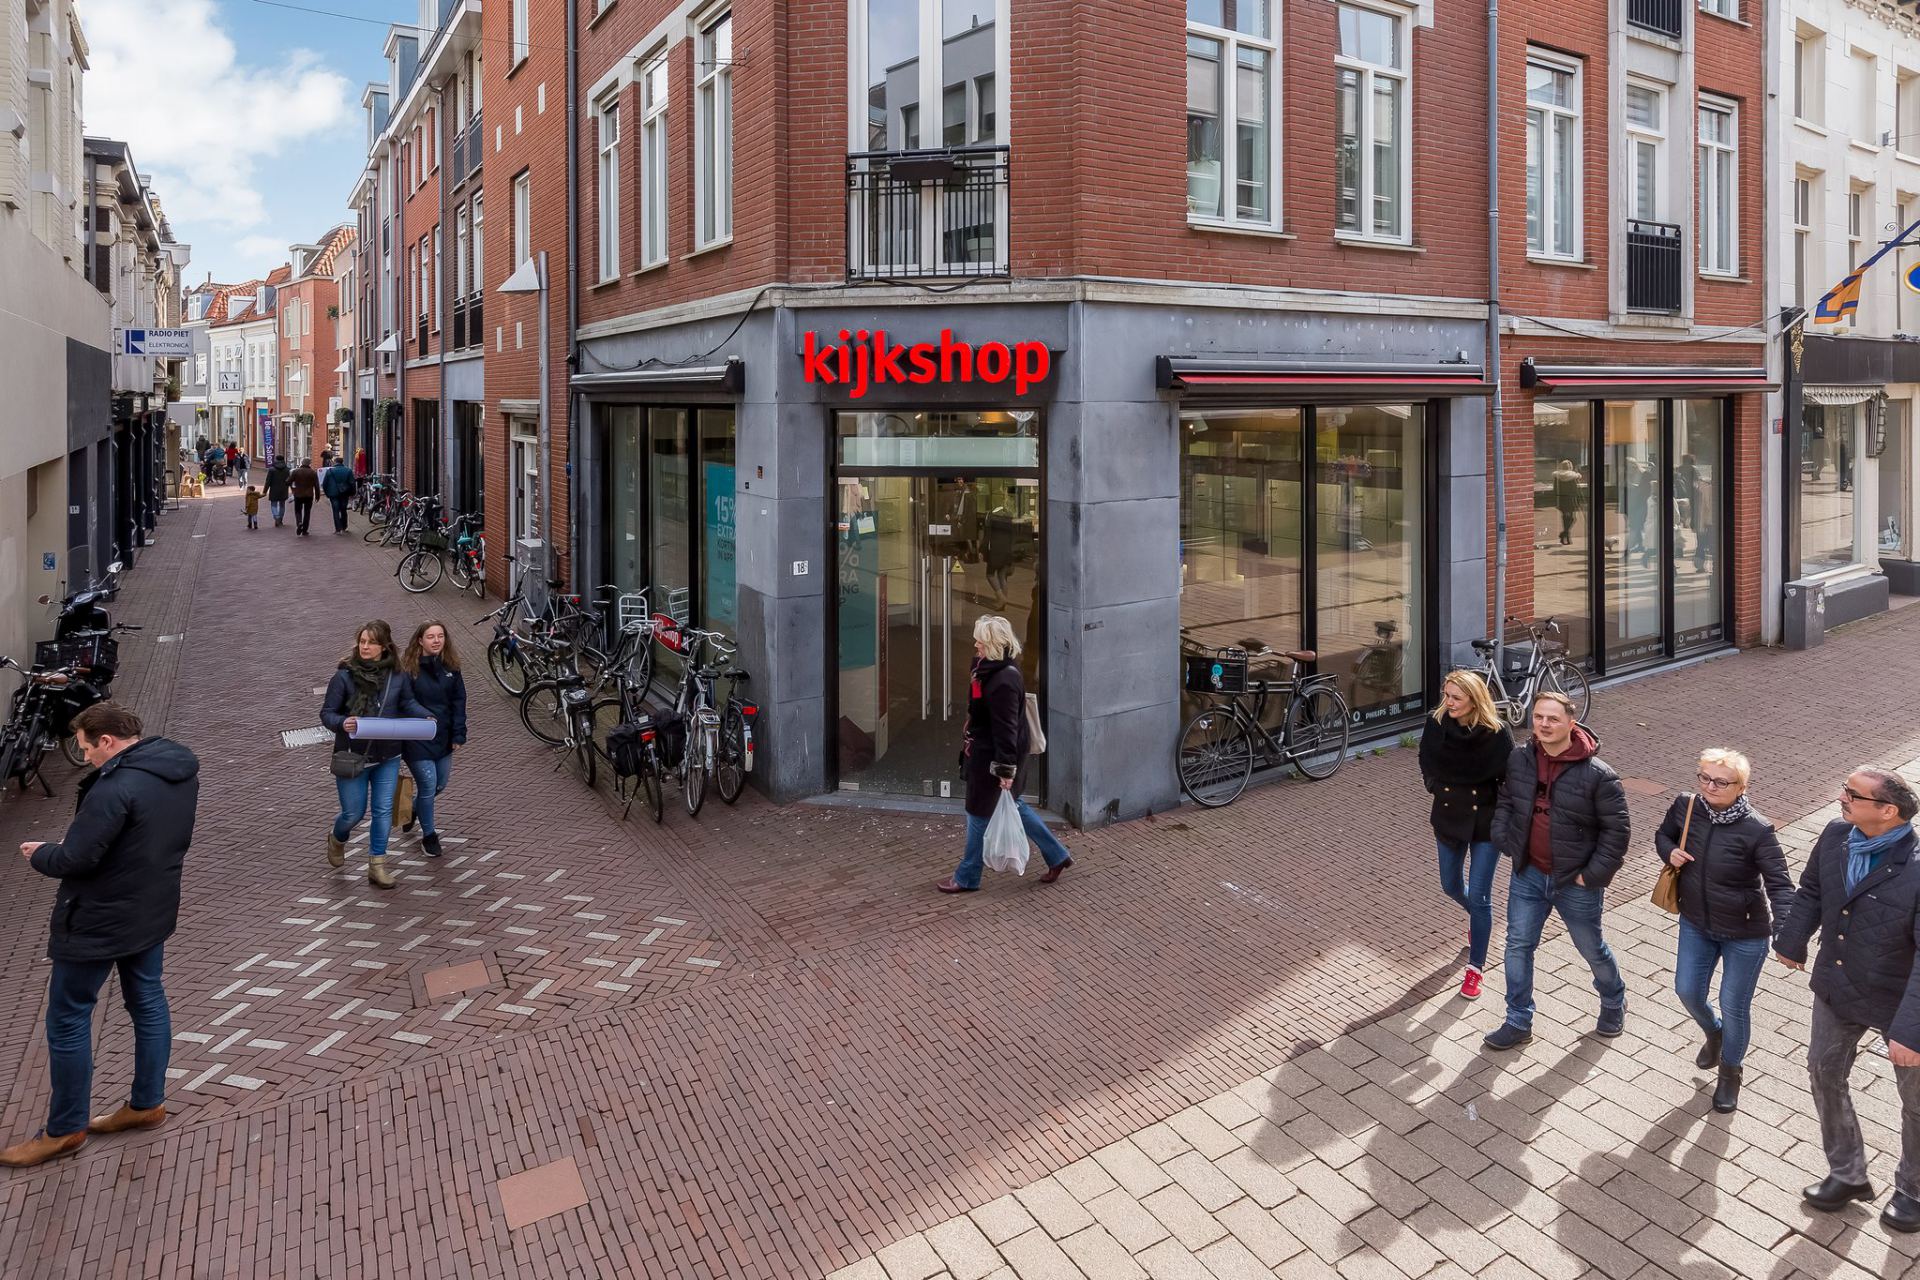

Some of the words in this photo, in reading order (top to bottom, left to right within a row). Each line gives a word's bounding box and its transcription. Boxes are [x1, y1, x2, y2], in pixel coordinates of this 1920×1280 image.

[148, 330, 173, 338] RADIO
[173, 330, 190, 338] PIET
[803, 329, 1050, 399] kijkshop
